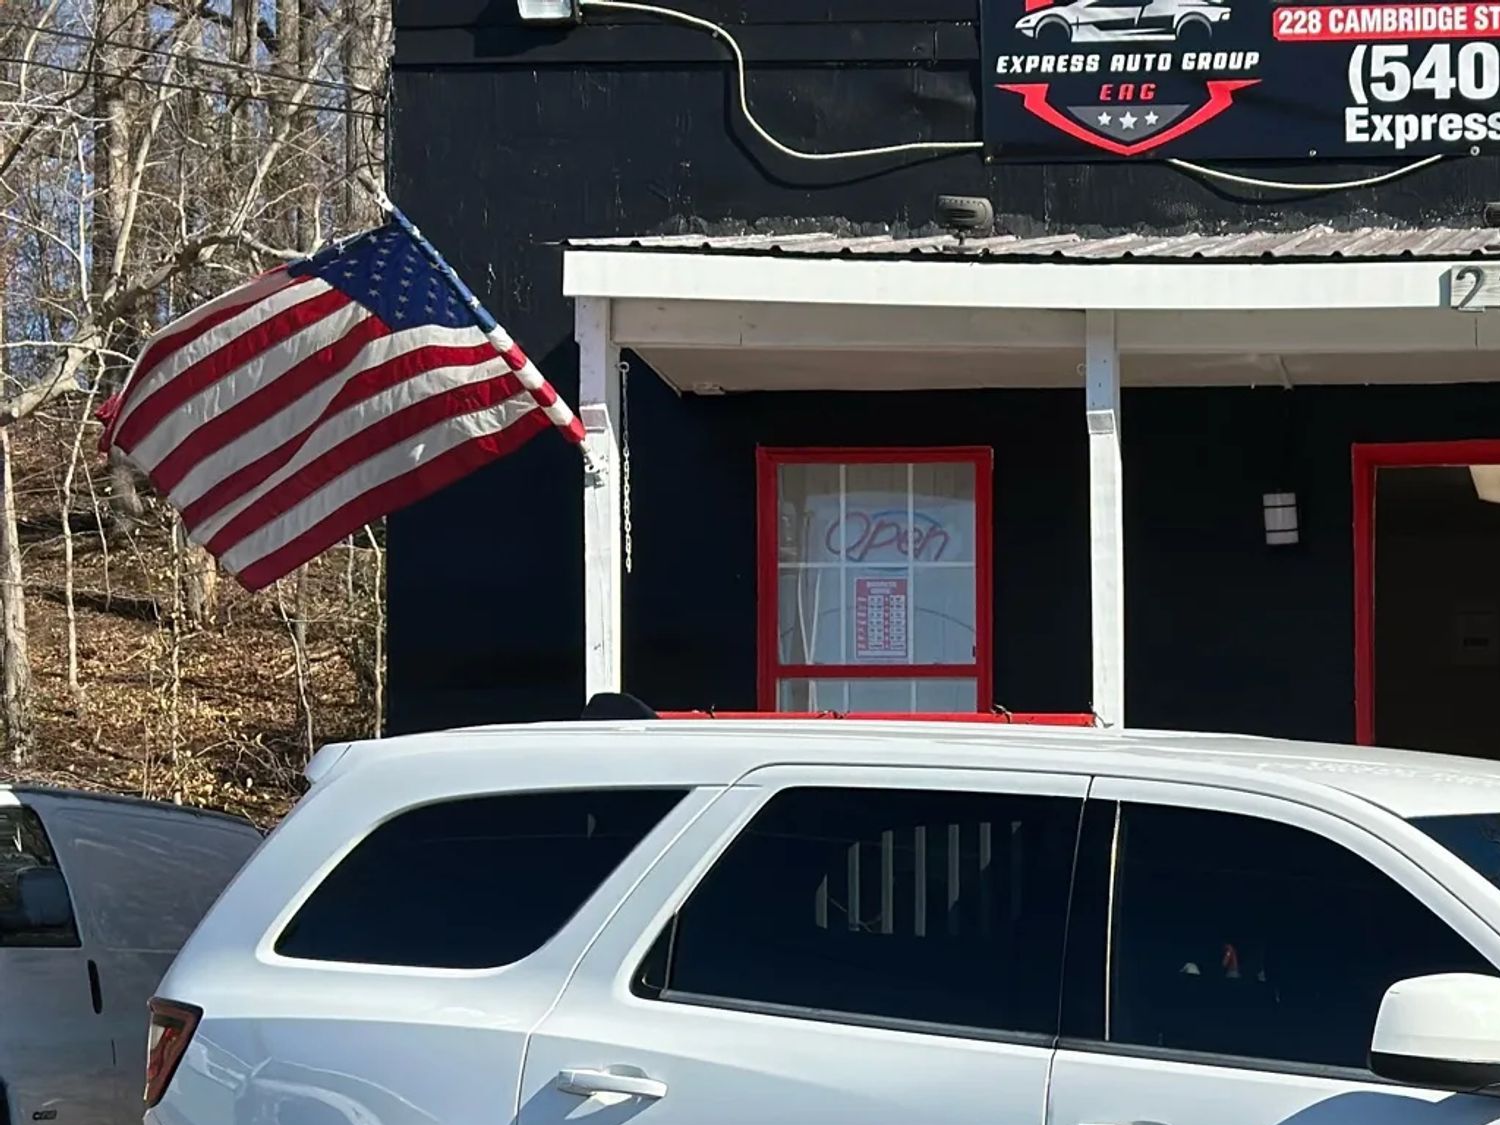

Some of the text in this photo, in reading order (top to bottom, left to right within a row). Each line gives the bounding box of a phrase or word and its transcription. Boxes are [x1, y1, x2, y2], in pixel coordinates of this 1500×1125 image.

[1278, 10, 1321, 34] 228
[1328, 6, 1466, 33] CAMBRIDGE
[996, 51, 1260, 74] EXPRESS AUTO GROUP
